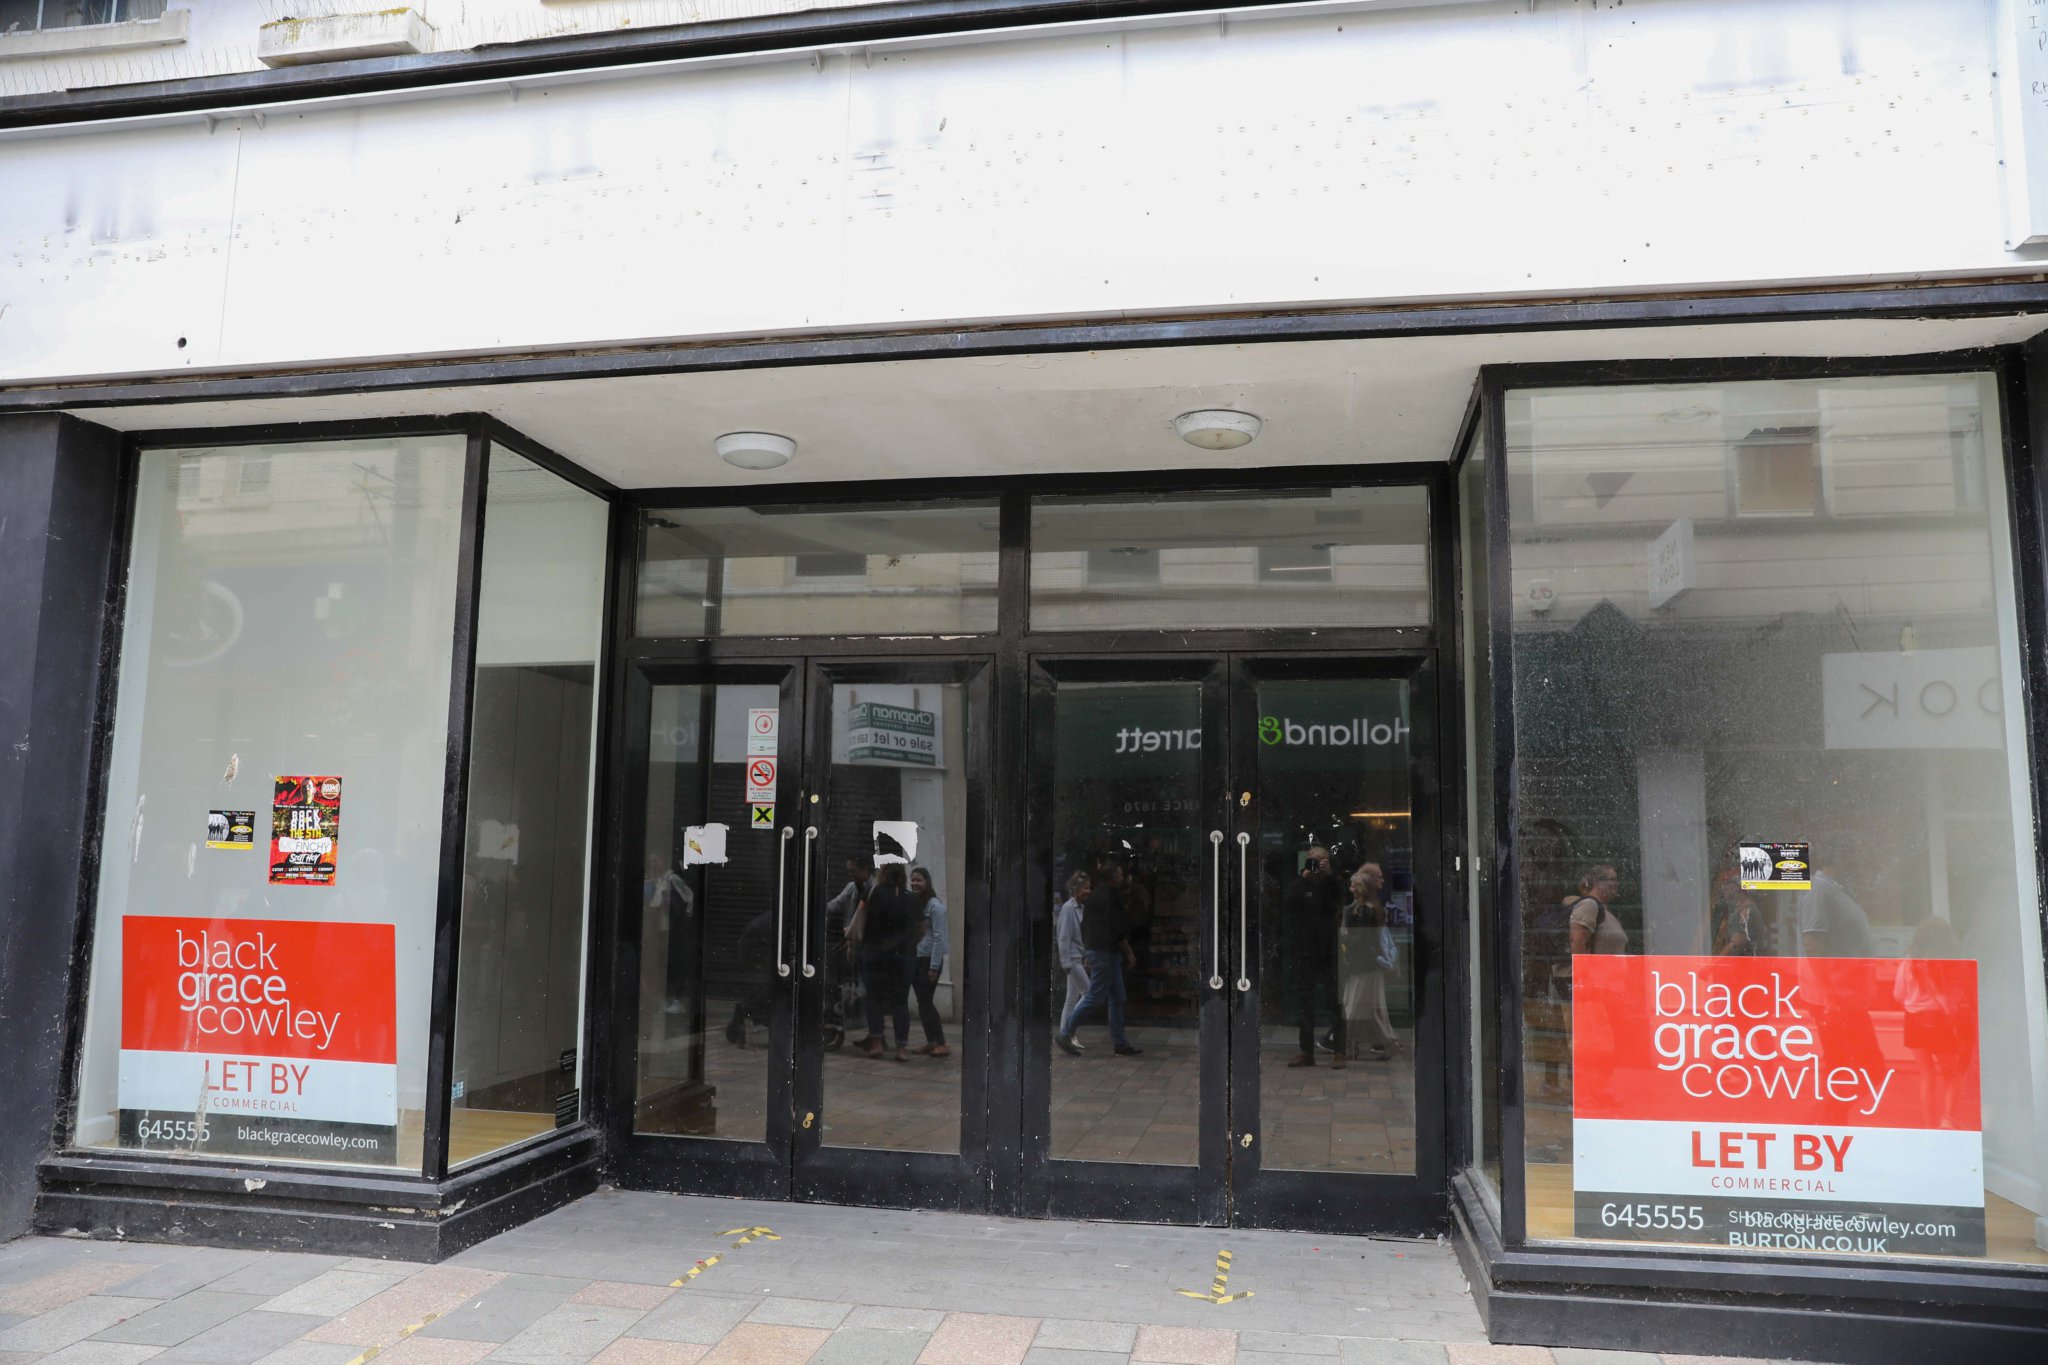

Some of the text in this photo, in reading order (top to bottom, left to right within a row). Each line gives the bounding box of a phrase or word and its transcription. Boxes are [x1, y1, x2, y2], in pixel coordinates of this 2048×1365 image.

[290, 820, 321, 830] BACK
[291, 809, 320, 821] BACK
[289, 829, 304, 838] THE
[176, 929, 279, 971] black
[178, 971, 287, 1011] grace
[1651, 971, 1802, 1019] black
[197, 999, 341, 1050] cowley
[1654, 1022, 1814, 1071] grace
[204, 1059, 310, 1096] LET BY
[1681, 1054, 1895, 1115] cowley
[213, 1097, 298, 1112] COMMERCIAL
[138, 1119, 378, 1150] 645555 blackgracecowley.com
[1691, 1131, 1854, 1173] LET BY
[1711, 1176, 1836, 1194] COMMERCIAL
[1601, 1203, 1956, 1239] 645555 blackgracecowley.com
[1728, 1231, 1889, 1253] BURTON.CO.UK
